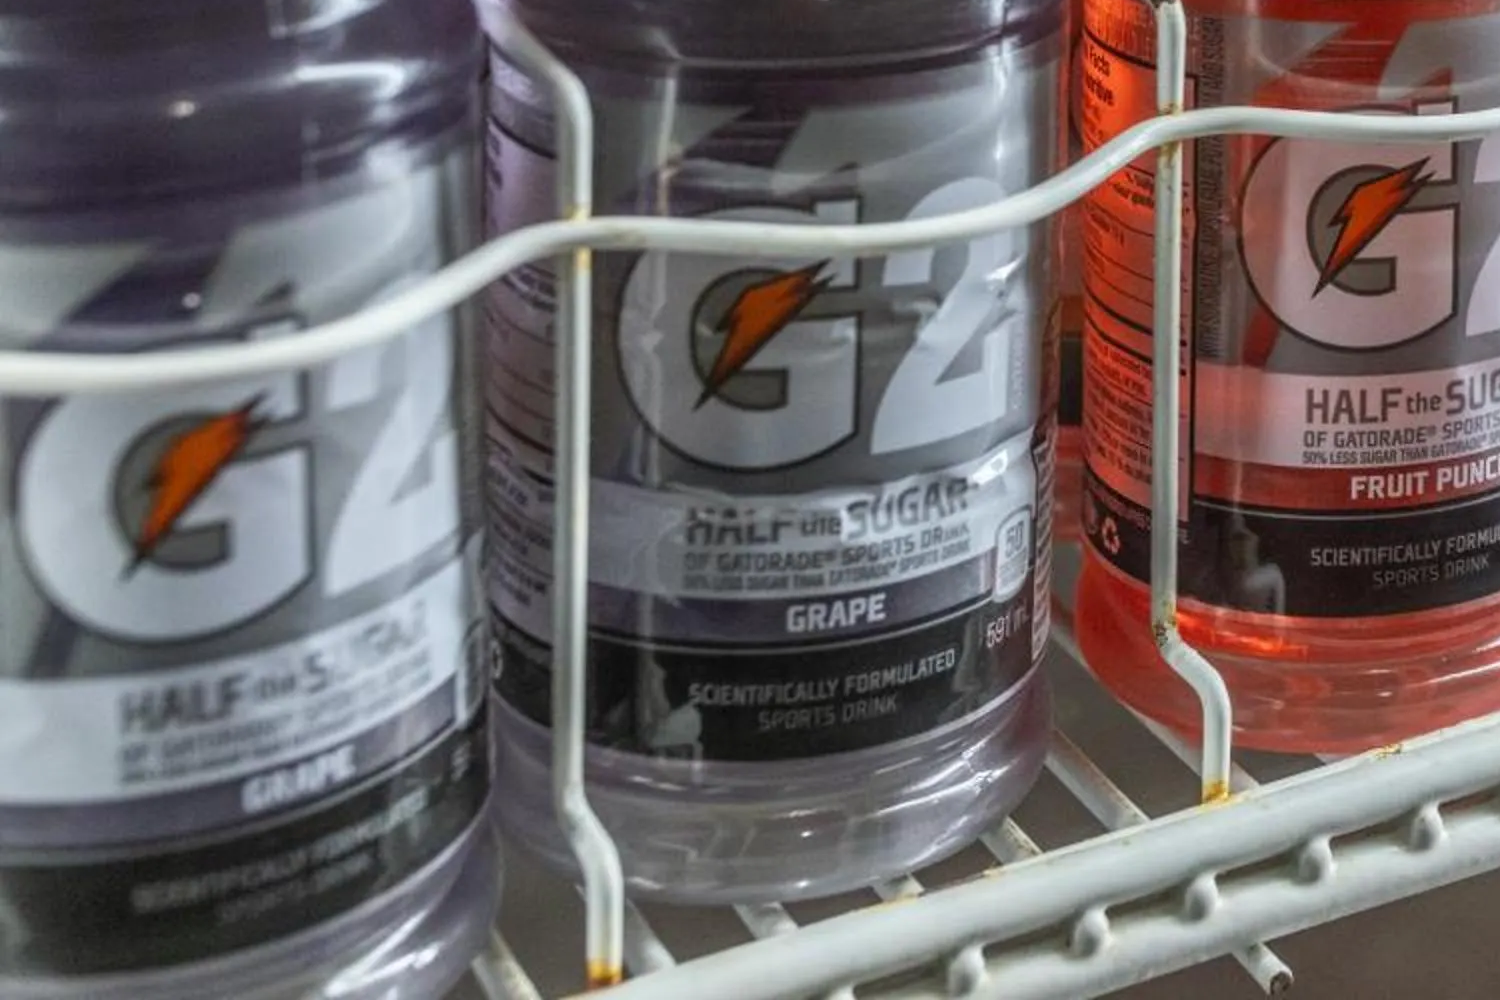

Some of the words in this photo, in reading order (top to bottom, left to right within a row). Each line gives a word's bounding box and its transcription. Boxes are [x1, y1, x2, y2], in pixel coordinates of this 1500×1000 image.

[1305, 388, 1403, 425] HALF
[1406, 391, 1442, 416] the
[1303, 429, 1328, 449] OF
[1330, 450, 1359, 465] LESS
[1360, 450, 1398, 465] SUGAR
[1350, 471, 1430, 500] FRUIT
[845, 477, 969, 541] SUGAR
[841, 535, 915, 566] SPORTS
[1310, 540, 1442, 567] SCIENTIFICALLY
[1372, 564, 1440, 589] SPORTS
[1445, 553, 1491, 579] DRINK
[786, 592, 888, 634] GRAPE
[688, 678, 840, 706] SCIENTIFICALLY
[844, 648, 956, 695] FORMULATED
[758, 704, 835, 732] SPORTS
[842, 694, 898, 723] DRINK
